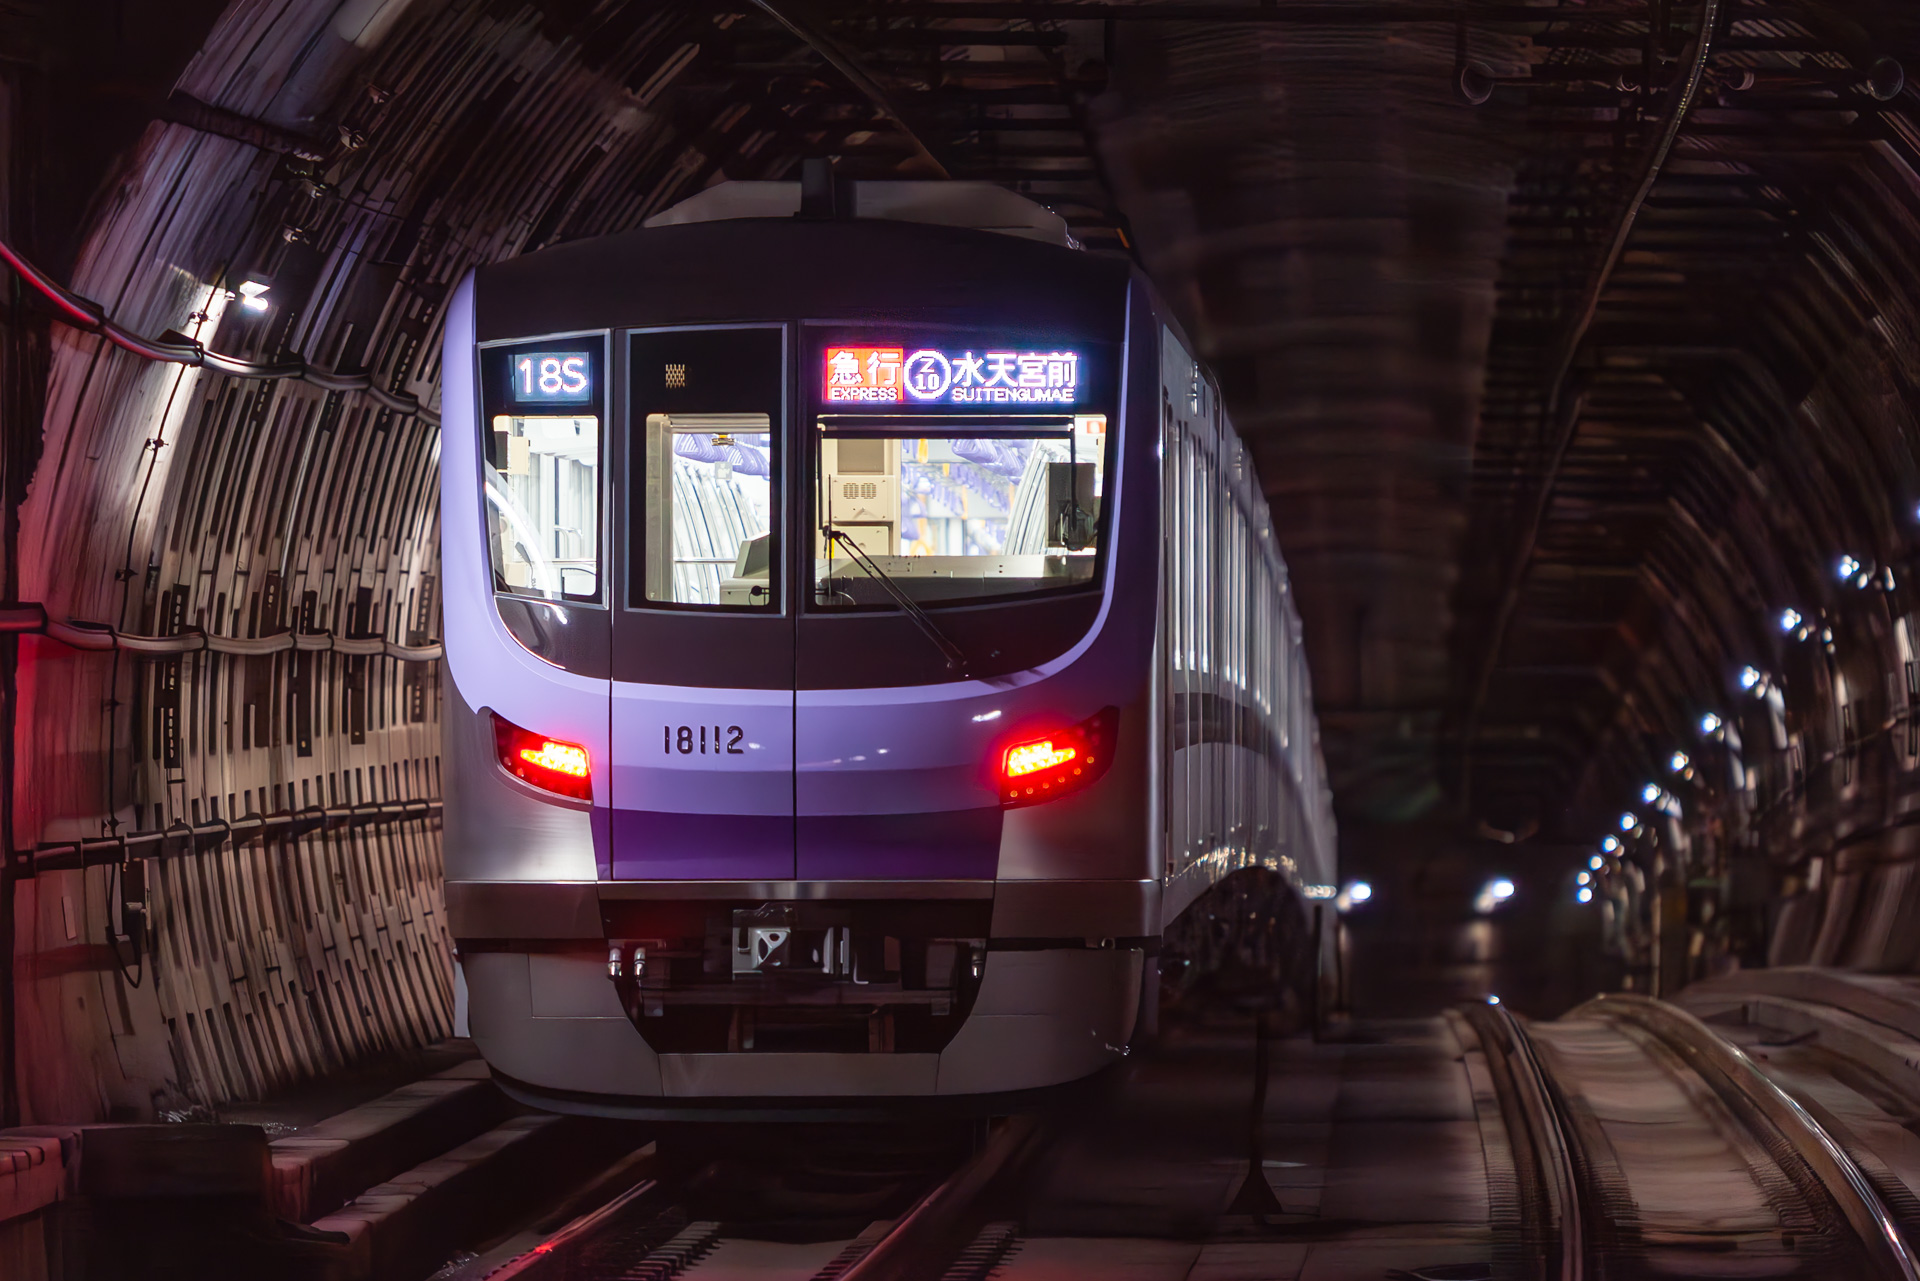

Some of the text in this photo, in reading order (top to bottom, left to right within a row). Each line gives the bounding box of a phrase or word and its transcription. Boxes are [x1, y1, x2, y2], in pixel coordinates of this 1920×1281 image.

[519, 357, 587, 394] 18S
[829, 350, 901, 385] 急行
[920, 357, 934, 373] Z
[951, 351, 1078, 387] 水天宮前
[831, 387, 897, 401] EXPRESS
[915, 374, 940, 390] 10
[664, 725, 745, 755] 18112
